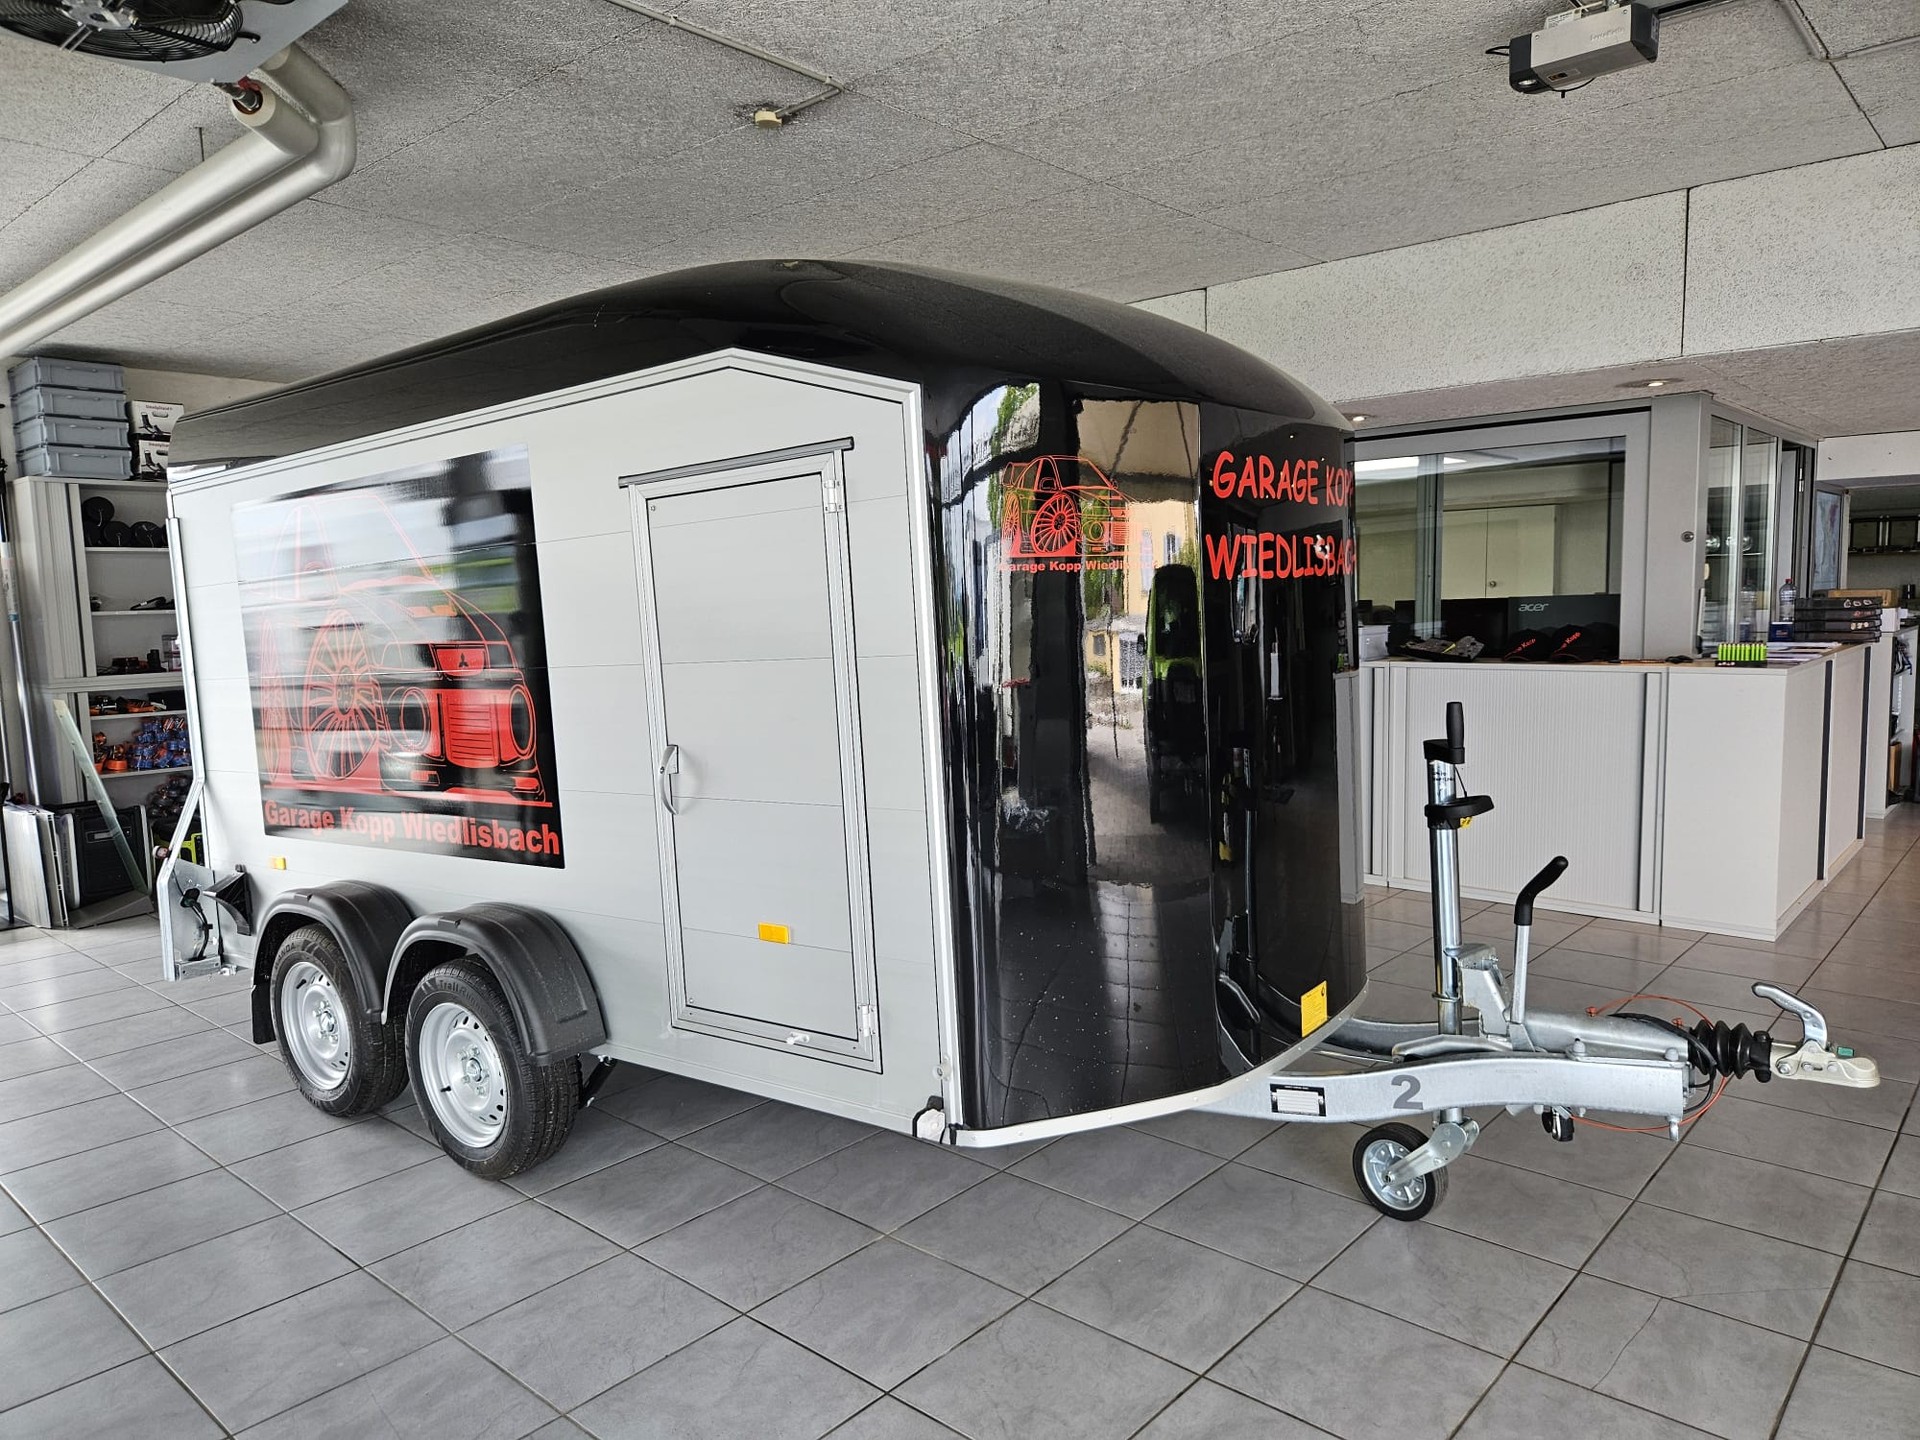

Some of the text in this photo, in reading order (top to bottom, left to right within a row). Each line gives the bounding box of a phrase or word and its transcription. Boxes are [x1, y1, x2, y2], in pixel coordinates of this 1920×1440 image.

[1212, 450, 1319, 505] GARAGE
[1049, 560, 1082, 573] Kopp
[1518, 603, 1549, 612] acer
[264, 800, 560, 855] Garage Kopp Wiedlisbach
[1391, 1074, 1424, 1111] 2
